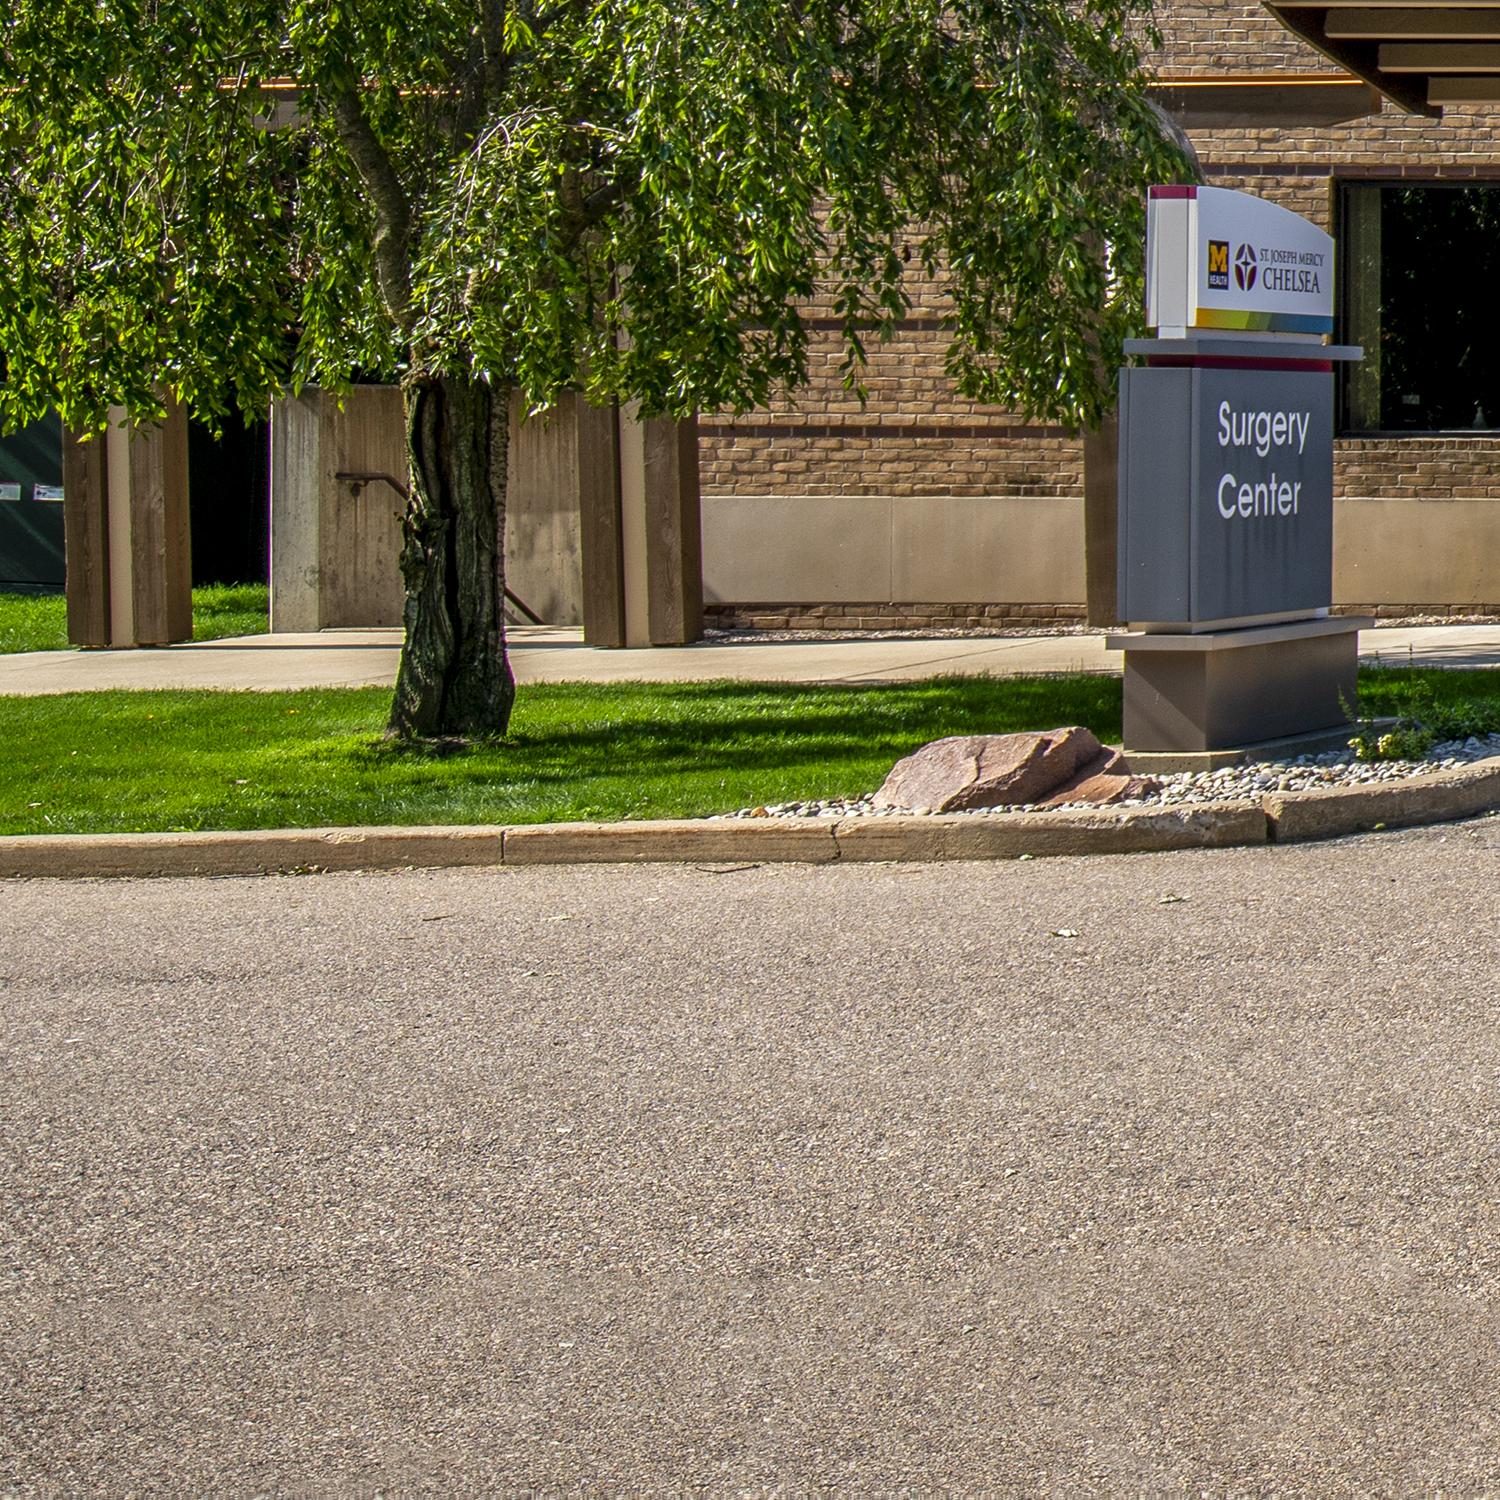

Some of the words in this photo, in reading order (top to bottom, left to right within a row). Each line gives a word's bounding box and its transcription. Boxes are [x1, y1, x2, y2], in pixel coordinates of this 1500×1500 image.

[1210, 245, 1228, 272] M
[1270, 249, 1298, 266] JOSEPH
[1298, 252, 1325, 267] MERCY
[1262, 267, 1321, 294] CHELSEA
[1218, 400, 1310, 457] Surgery
[1217, 473, 1301, 519] Center
